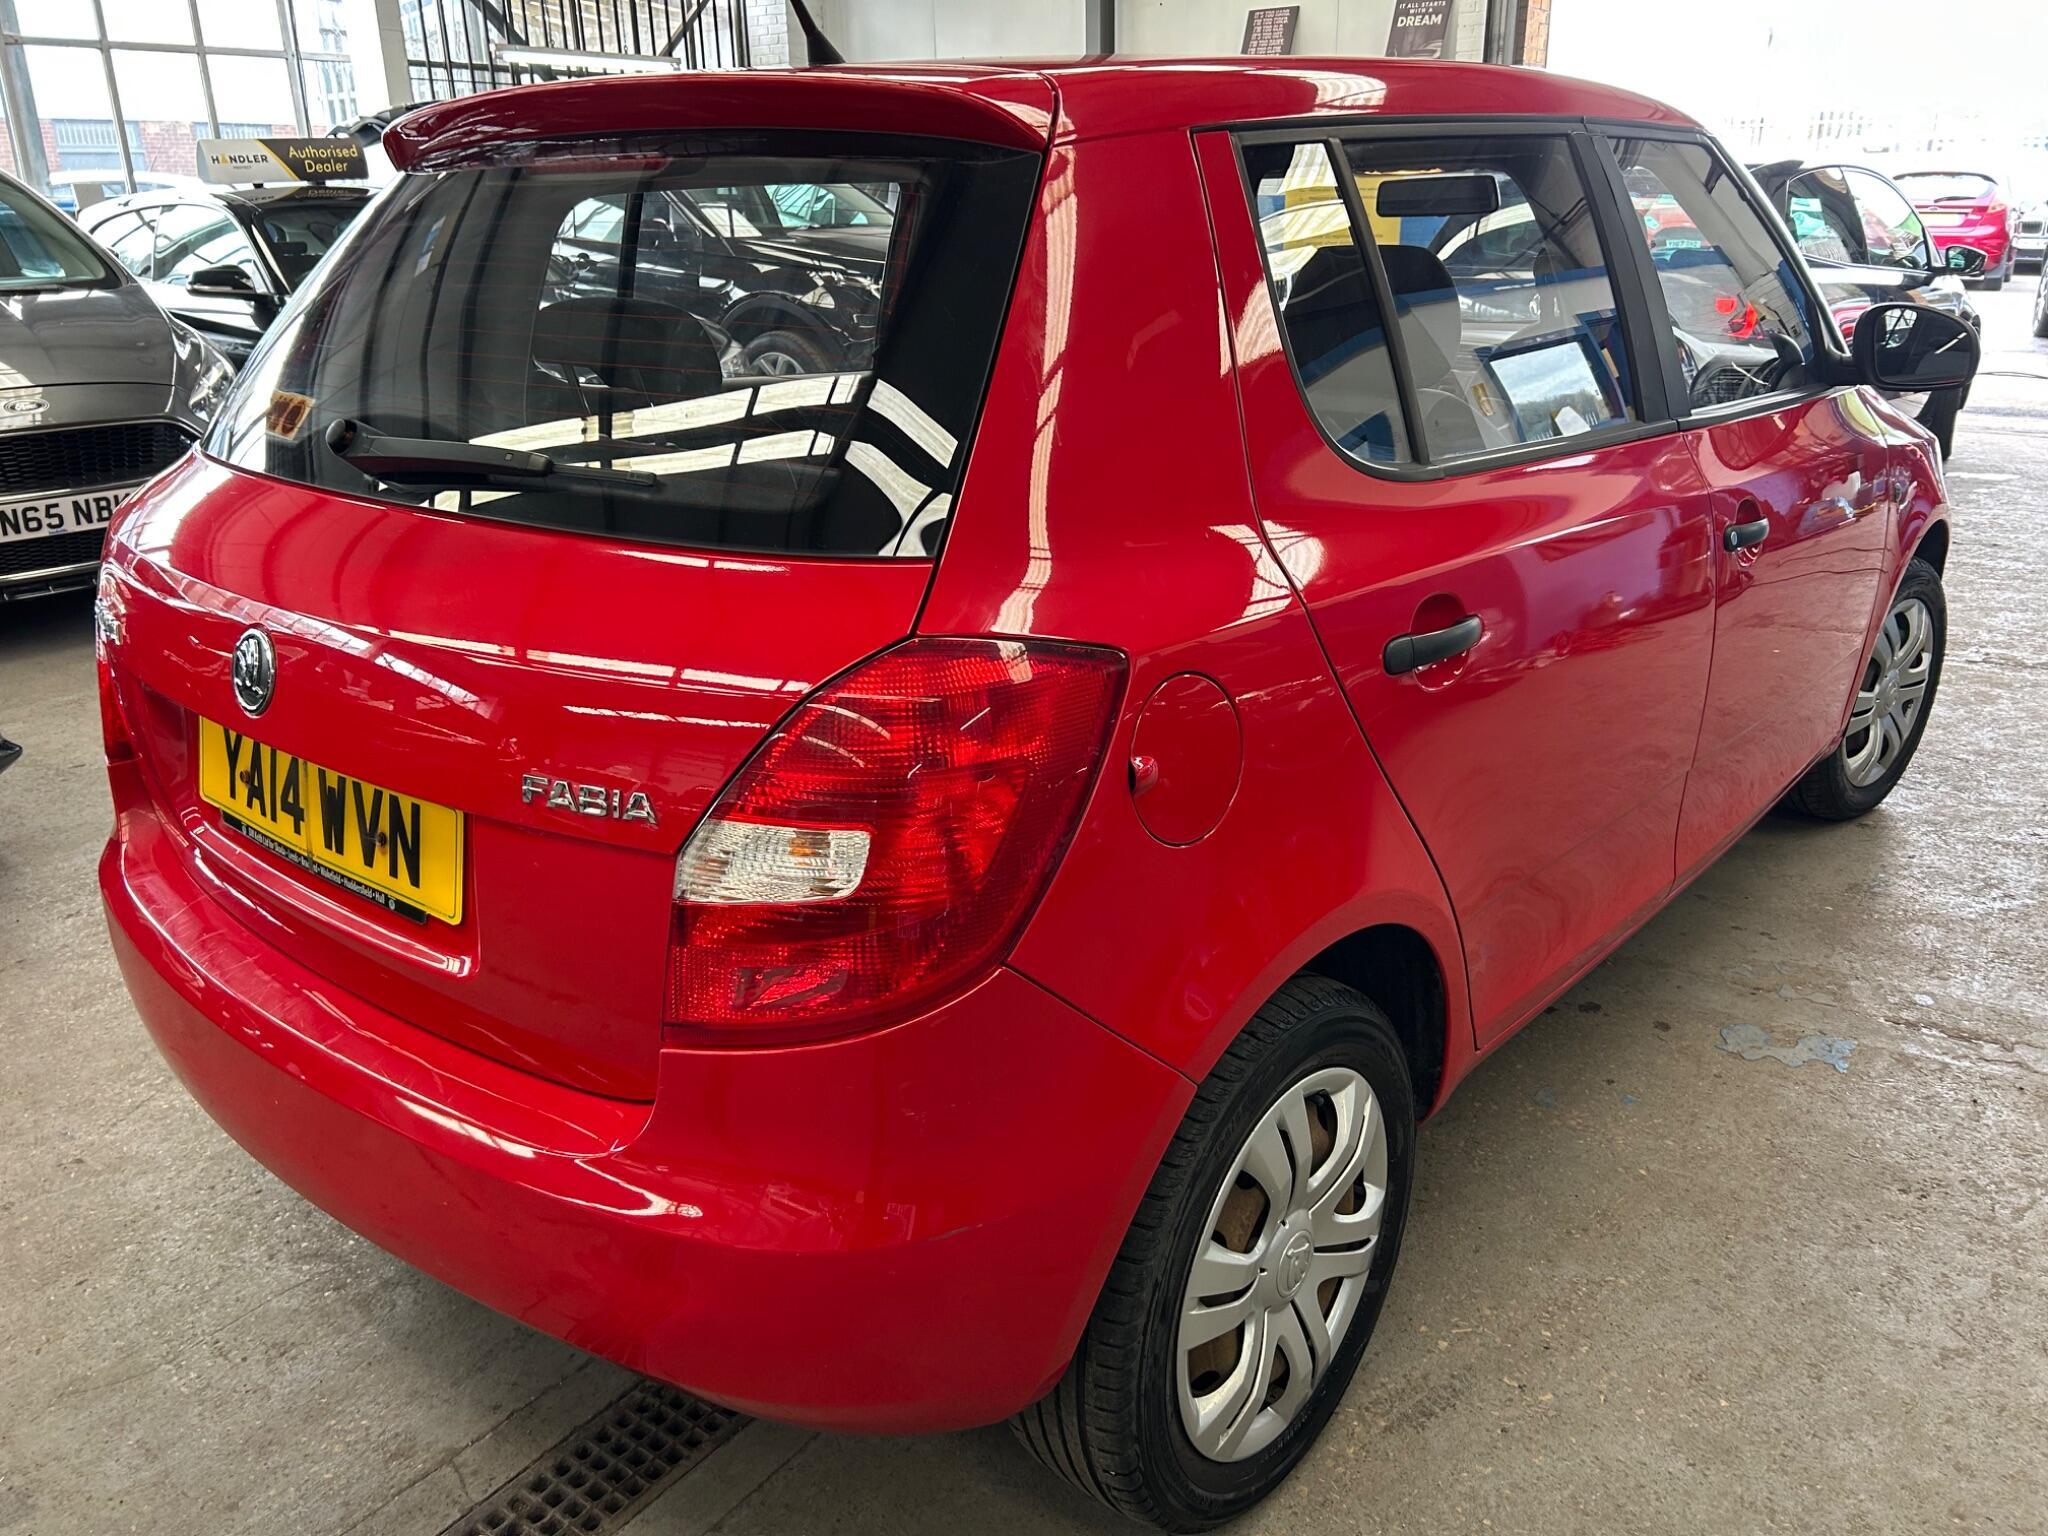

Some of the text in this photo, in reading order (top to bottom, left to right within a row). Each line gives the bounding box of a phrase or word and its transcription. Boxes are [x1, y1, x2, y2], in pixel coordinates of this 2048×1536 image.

[1397, 13, 1443, 27] DREAM
[288, 145, 358, 160] Authorised
[304, 160, 348, 173] Dealer
[522, 774, 657, 824] FABIA
[317, 766, 421, 889] WVN
